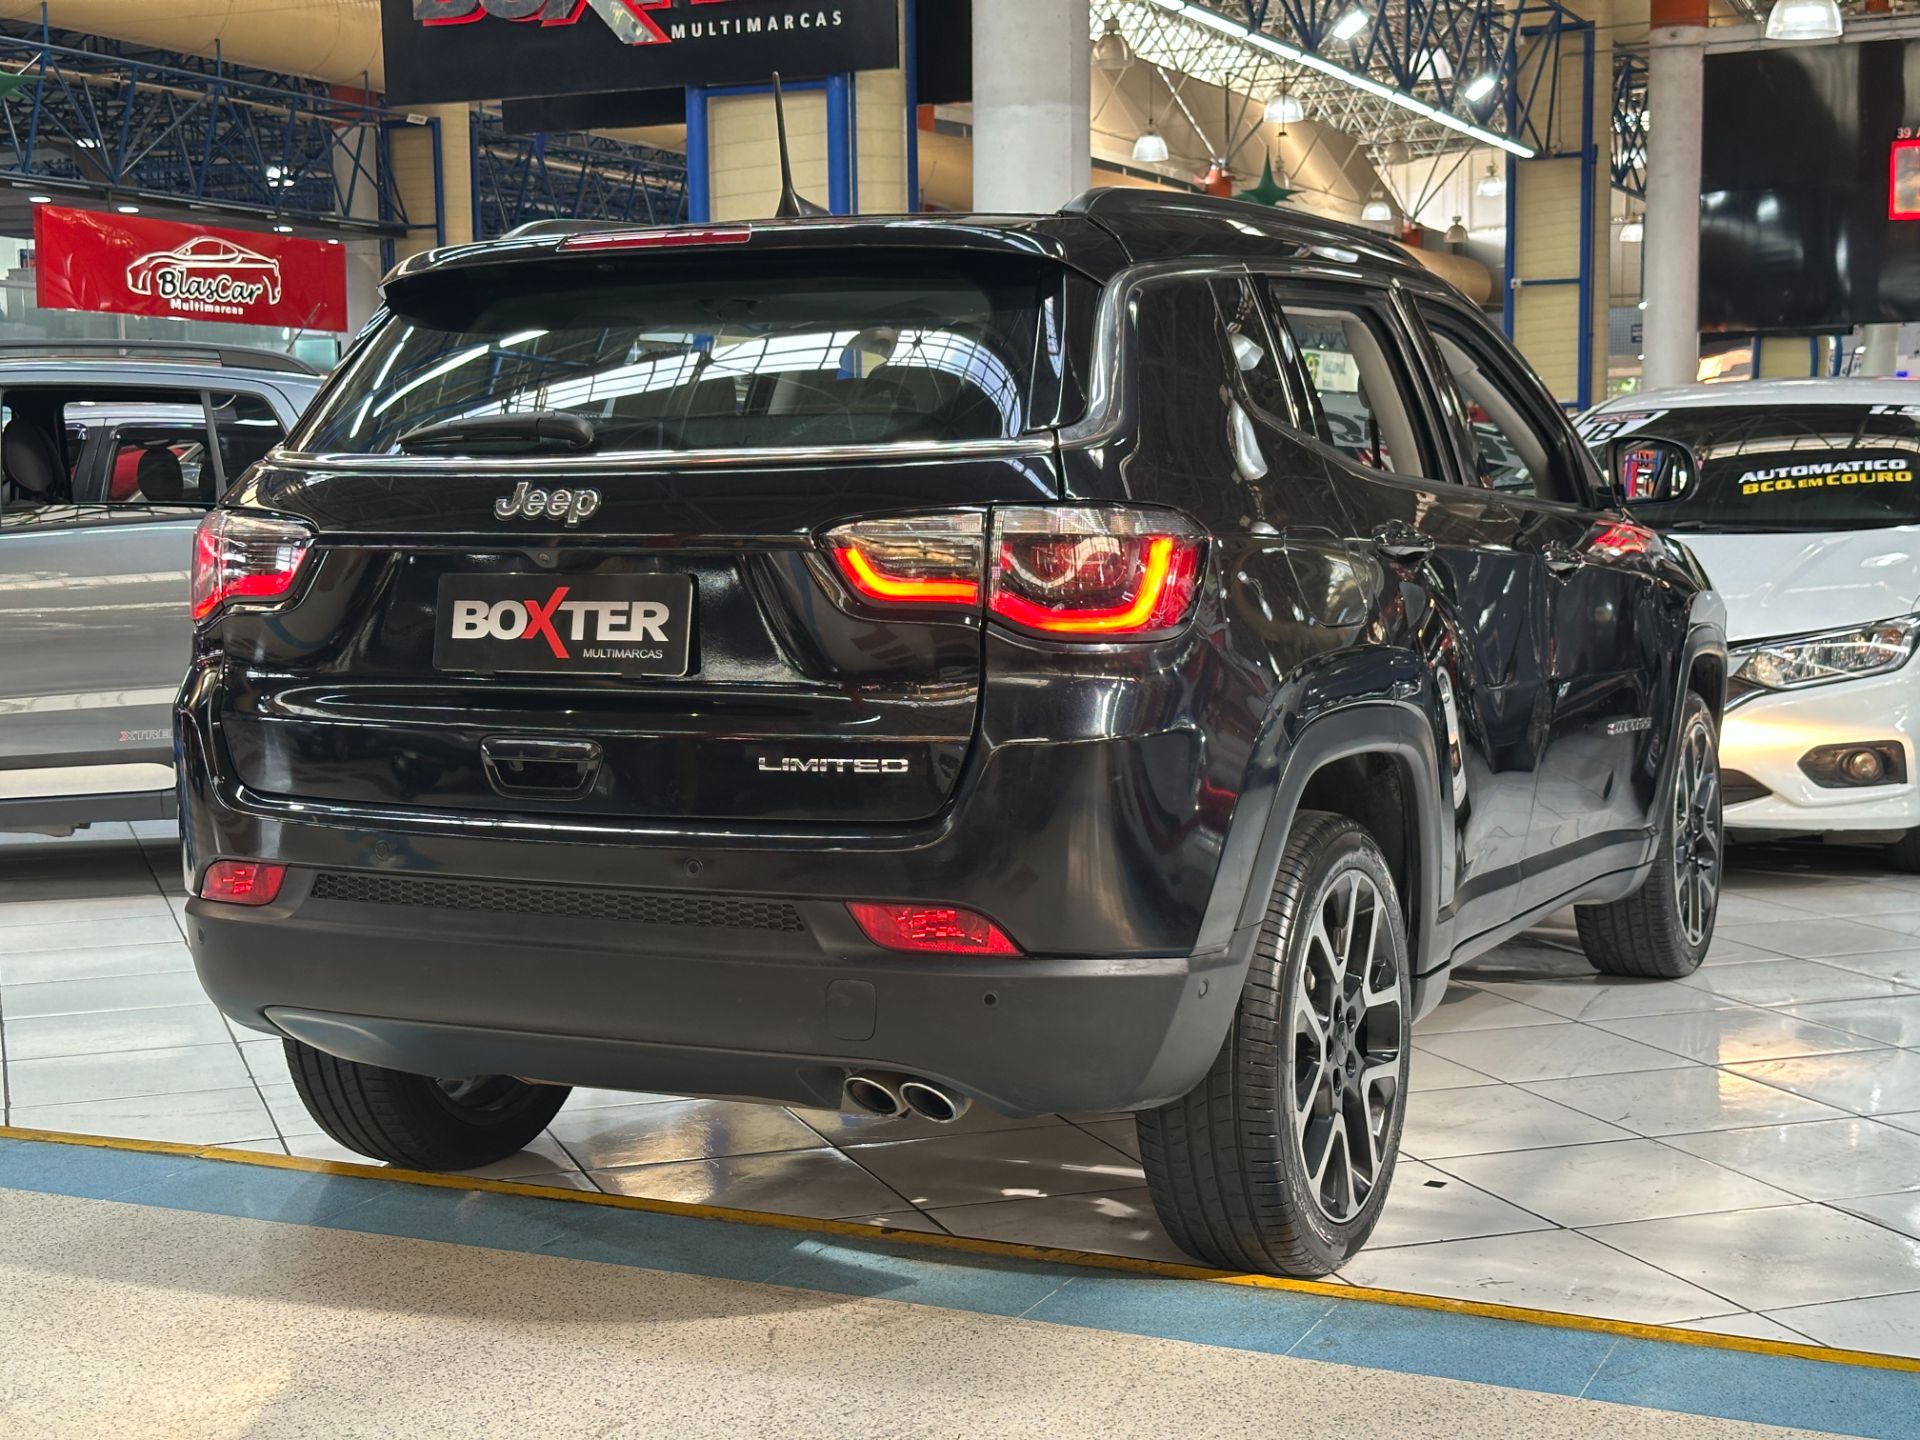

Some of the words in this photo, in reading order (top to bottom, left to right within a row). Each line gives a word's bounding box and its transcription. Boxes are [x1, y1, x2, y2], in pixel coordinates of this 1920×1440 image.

[671, 10, 844, 41] MULTIMARCAS
[157, 267, 263, 305] BlasCar
[1738, 458, 1908, 484] AUTOMATICO
[1798, 477, 1823, 489] EM
[1826, 471, 1913, 486] COURO
[495, 481, 600, 526] Jeep
[451, 586, 670, 659] BOXTER
[582, 648, 663, 659] MULTIMARCAS
[119, 728, 174, 742] XTRE
[758, 756, 909, 773] LIMITED
